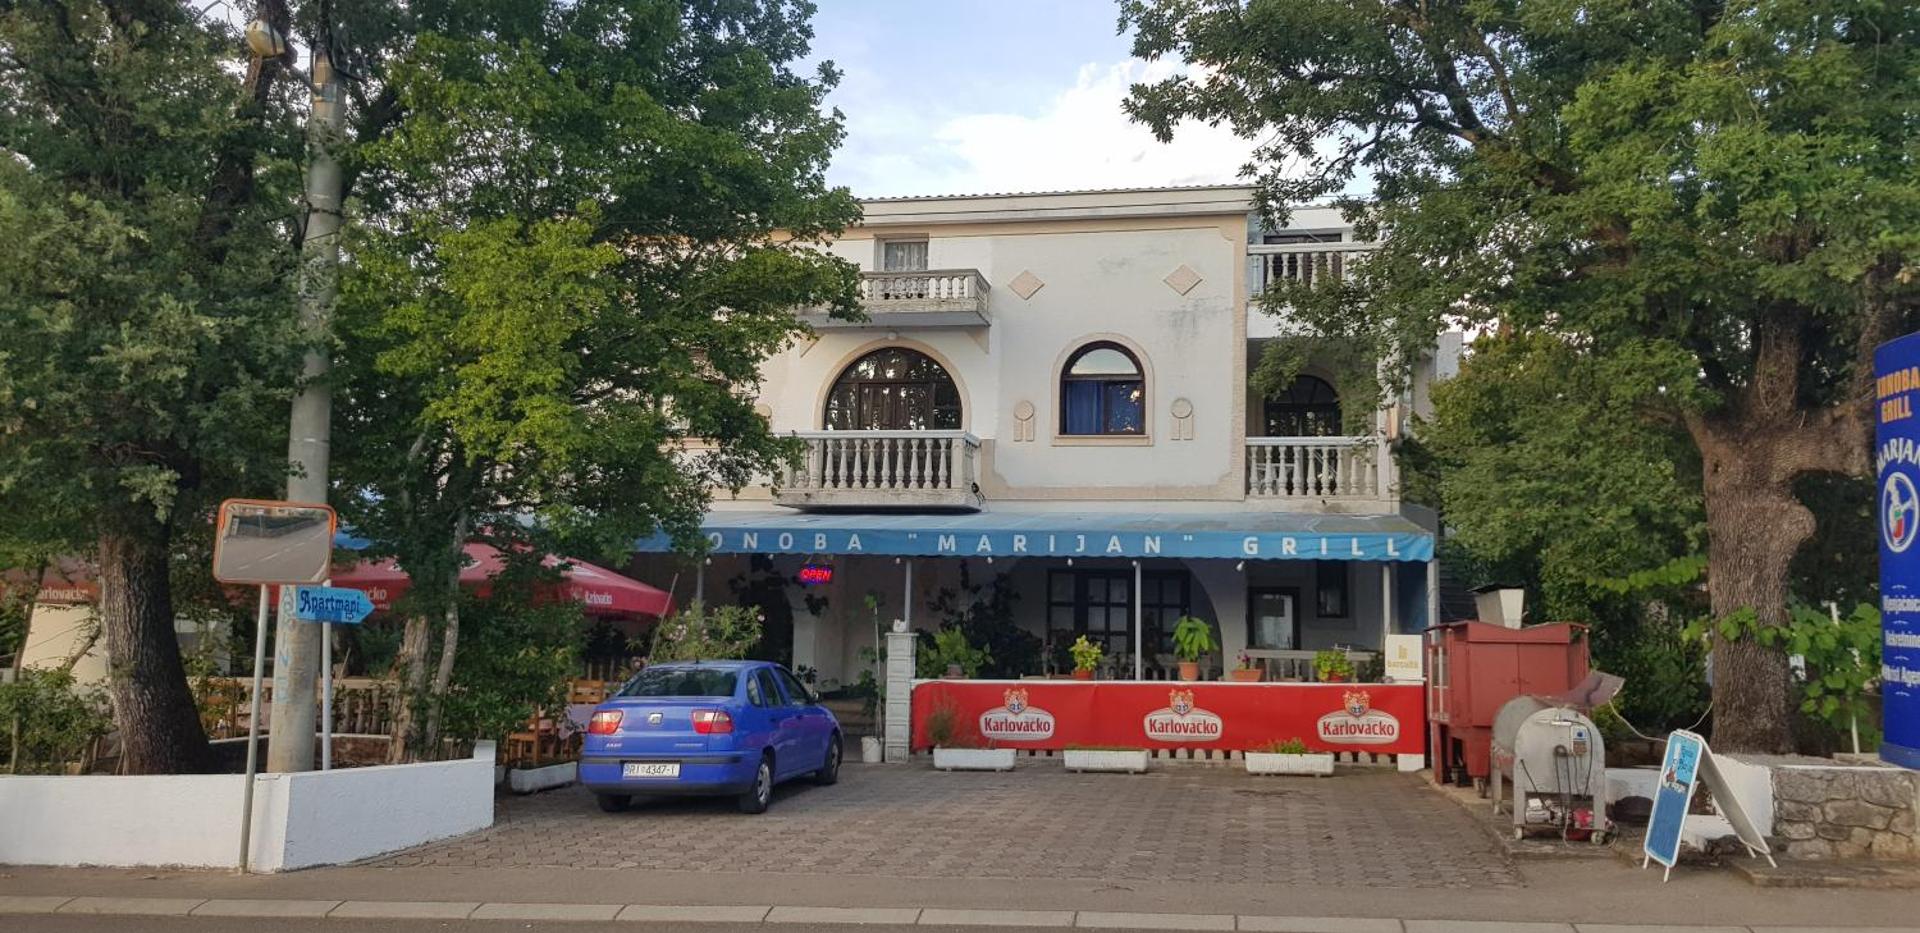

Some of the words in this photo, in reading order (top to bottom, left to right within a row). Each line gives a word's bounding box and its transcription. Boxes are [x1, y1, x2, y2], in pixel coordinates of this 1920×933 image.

[1881, 396, 1912, 424] GRILL
[709, 532, 862, 552] ONOBA
[1243, 536, 1401, 557] GRILL
[800, 568, 832, 582] OPEN
[299, 590, 361, 613] Apartmani
